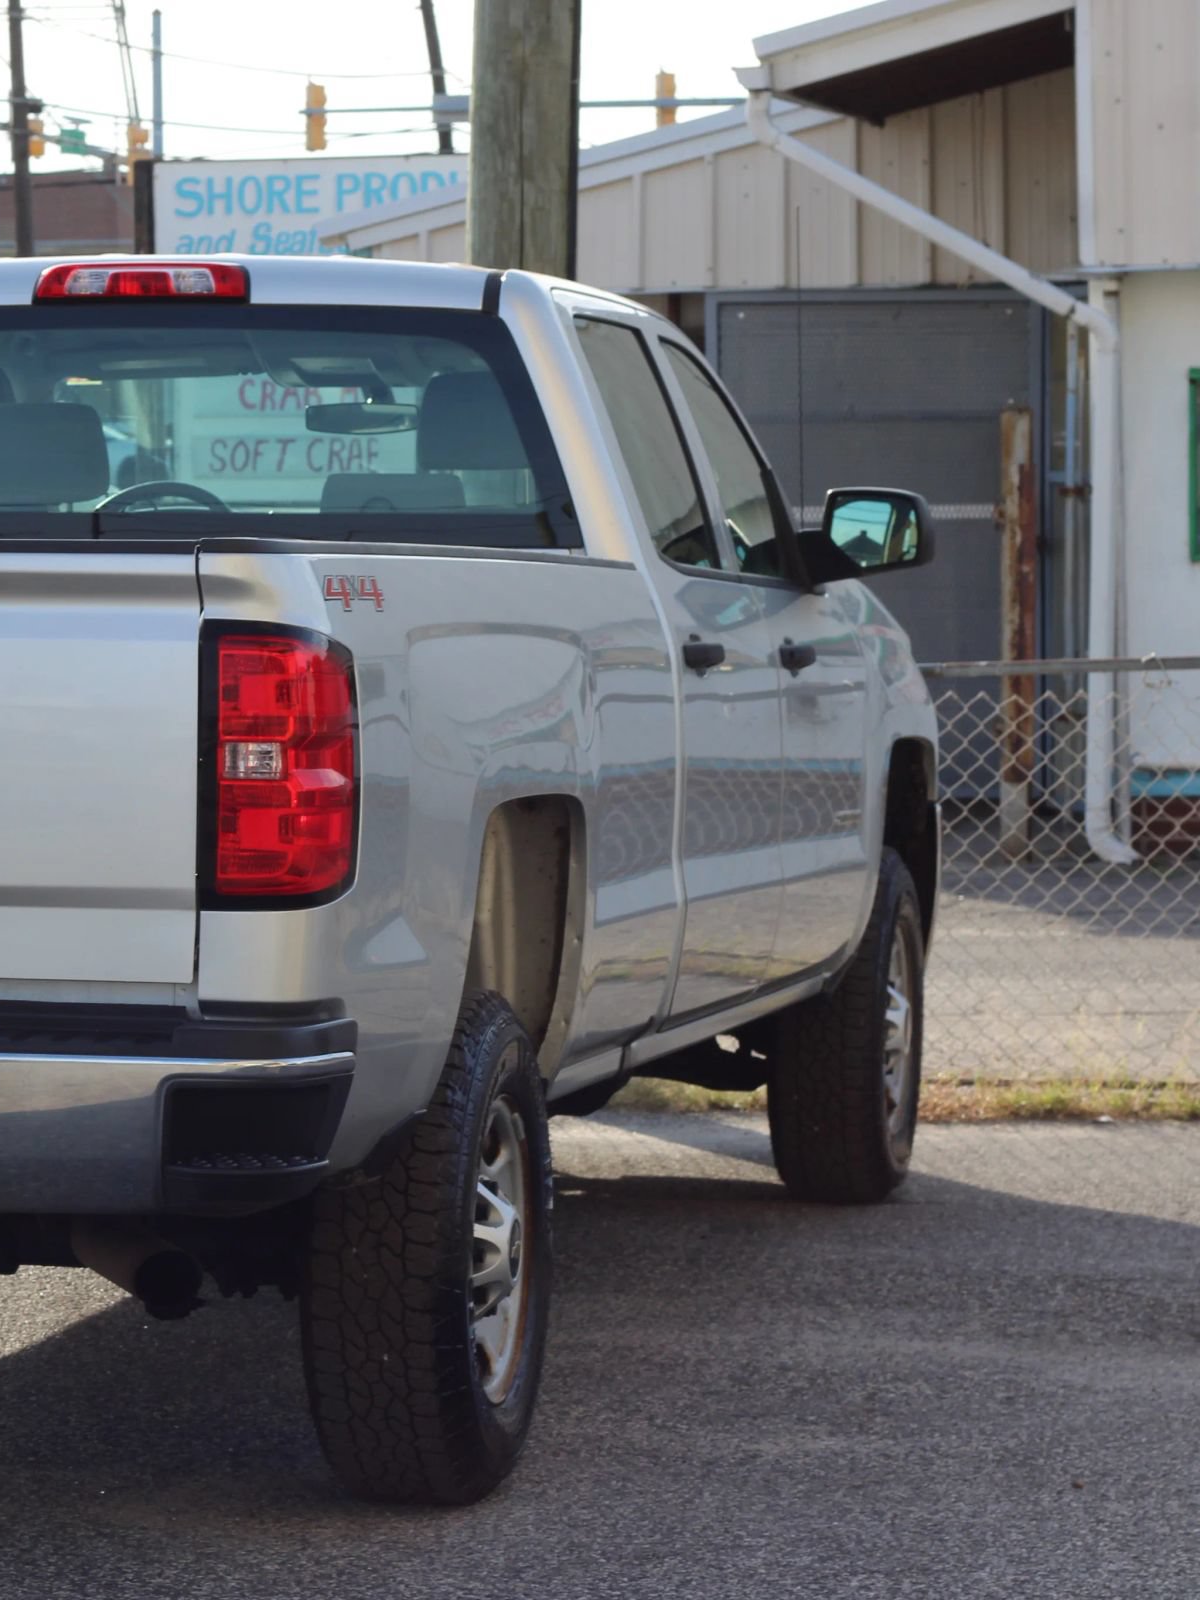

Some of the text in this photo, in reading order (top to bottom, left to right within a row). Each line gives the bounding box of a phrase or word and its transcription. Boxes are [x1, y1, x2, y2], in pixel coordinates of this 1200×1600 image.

[174, 173, 321, 218] SHORE
[175, 227, 237, 254] and
[208, 437, 296, 473] SOFT
